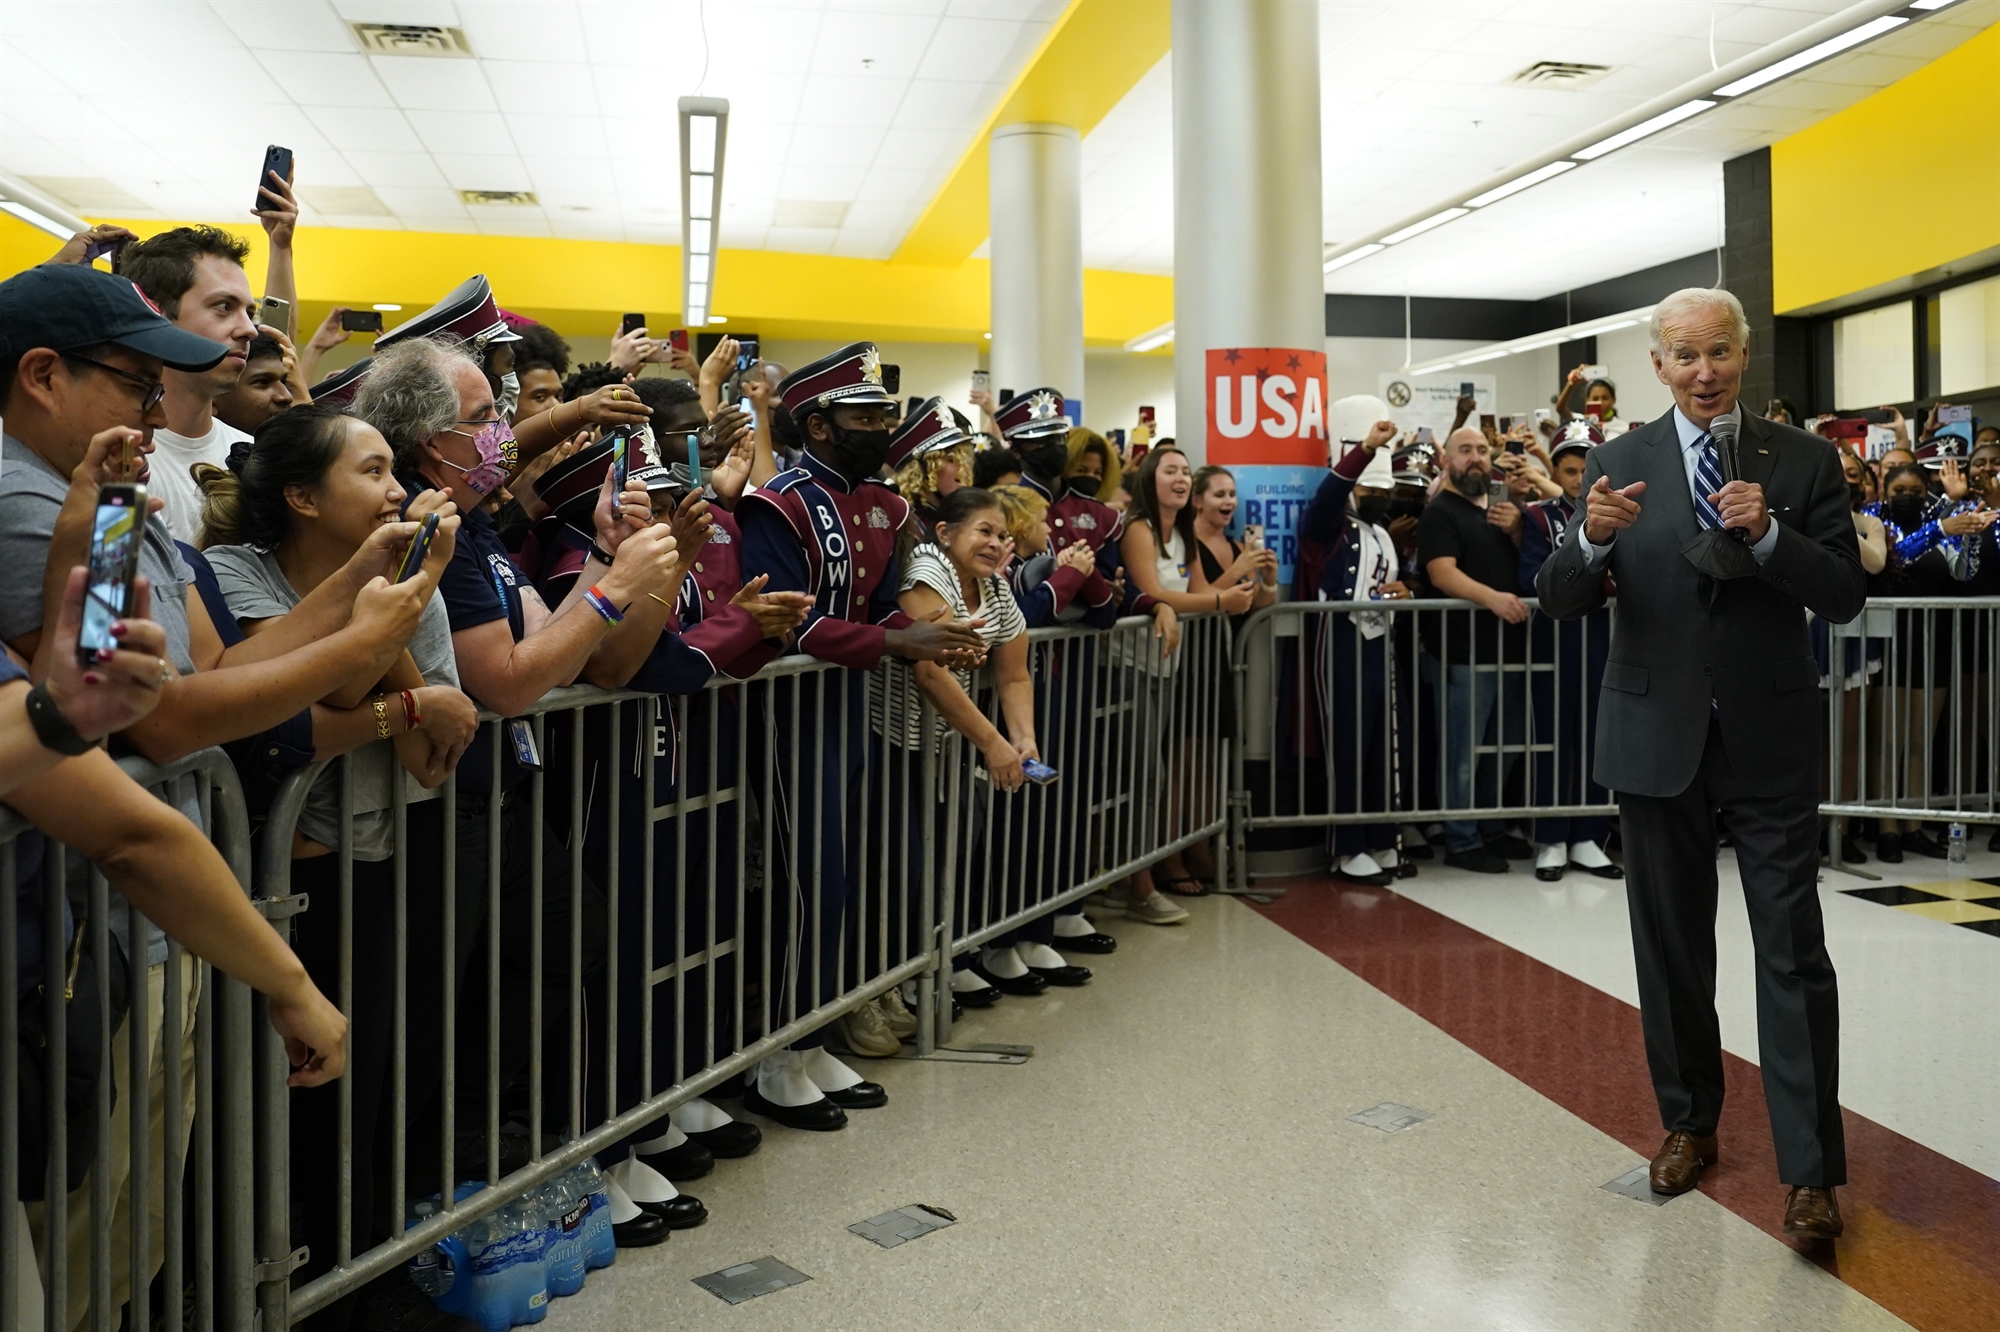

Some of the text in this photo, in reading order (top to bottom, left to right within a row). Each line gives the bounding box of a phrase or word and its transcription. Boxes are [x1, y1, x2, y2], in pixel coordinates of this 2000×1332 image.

[1215, 374, 1325, 440] USA
[1256, 484, 1305, 494] BUILDING
[1245, 499, 1312, 531] BETT
